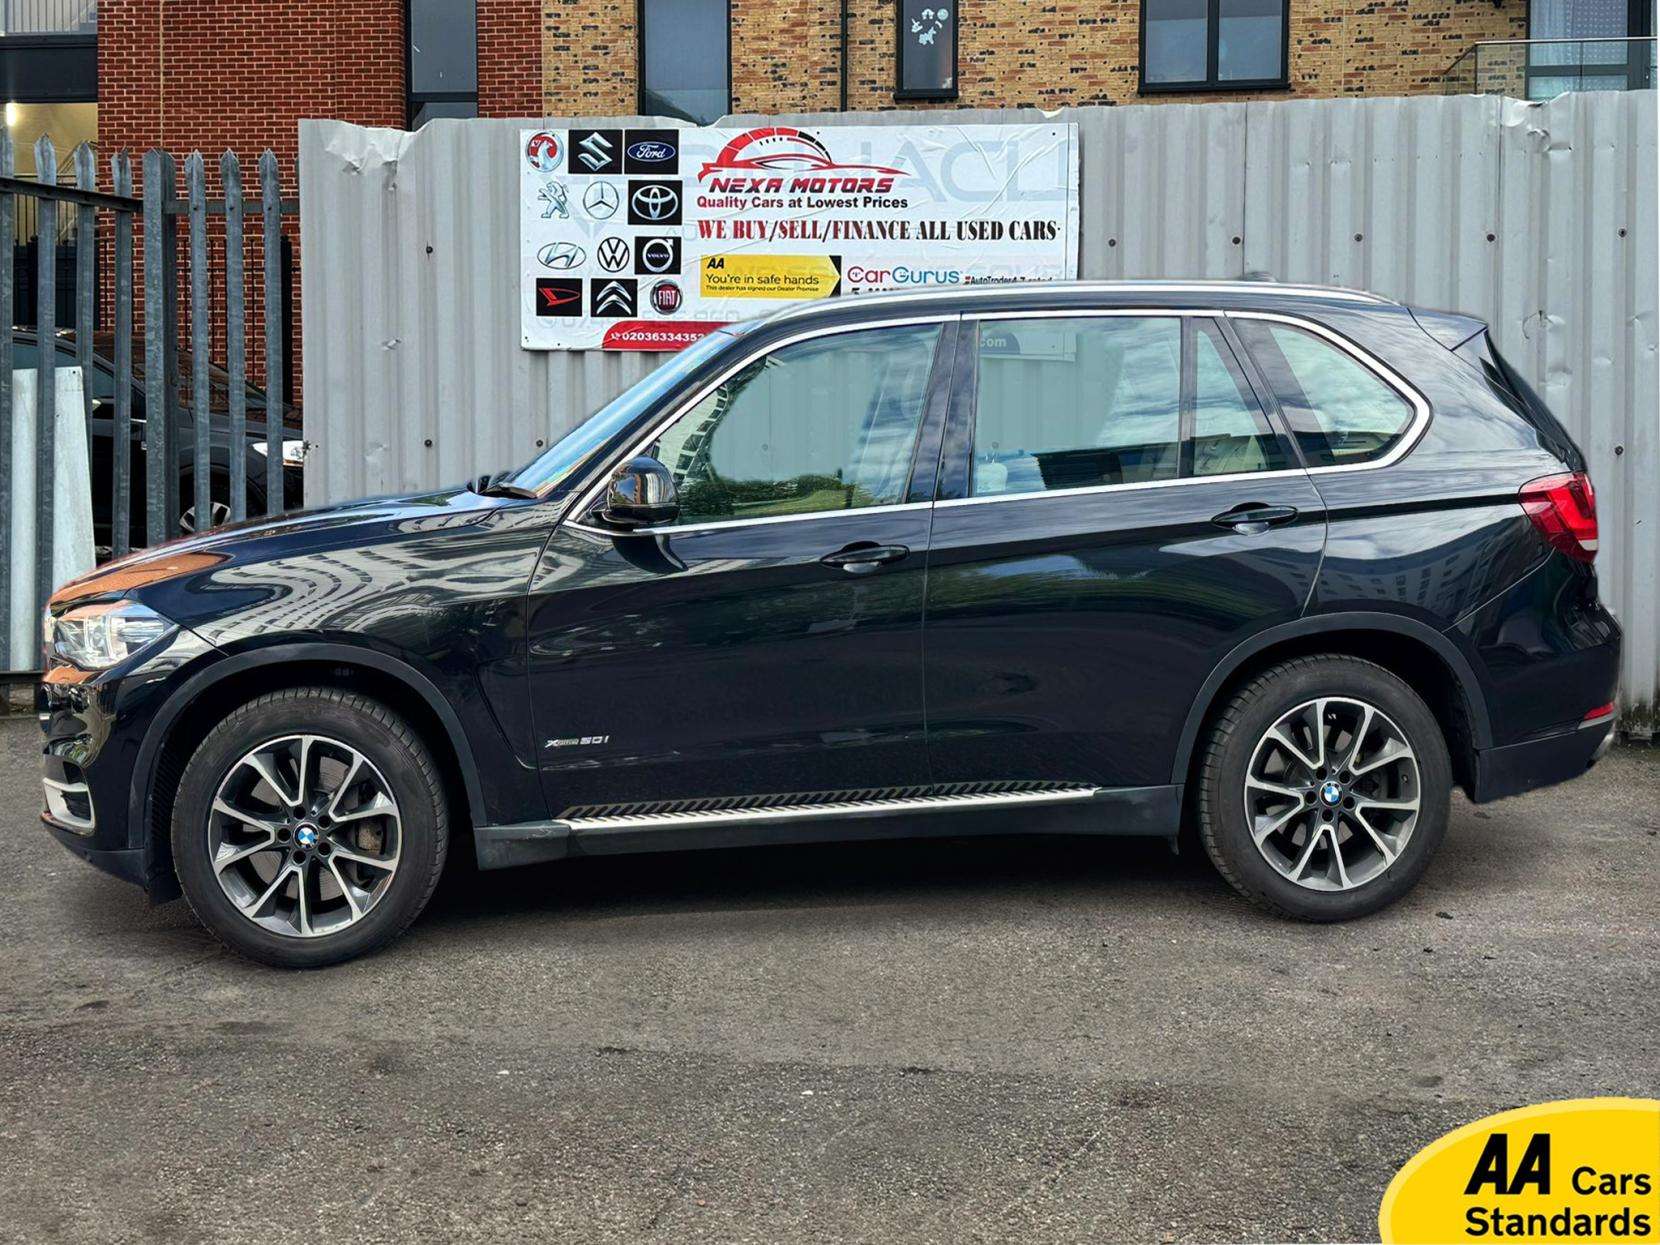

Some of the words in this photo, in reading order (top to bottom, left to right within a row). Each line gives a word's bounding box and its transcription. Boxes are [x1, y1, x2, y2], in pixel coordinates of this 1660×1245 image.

[636, 145, 666, 159] Ford
[709, 178, 783, 194] NEXA
[789, 178, 895, 194] MOTORS
[697, 196, 748, 210] Quality
[752, 196, 784, 209] Cars
[788, 197, 803, 208] at
[807, 197, 859, 209] Lowest
[863, 197, 908, 208] Prices
[697, 220, 727, 240] WE
[733, 219, 911, 243] BUY/SELL/FINANCE
[917, 220, 951, 241] ALL
[956, 220, 1004, 241] USED
[1008, 220, 1057, 241] CARS
[707, 258, 725, 269] AA
[706, 274, 740, 284] You're
[744, 275, 754, 284] in
[757, 274, 781, 285] safe
[784, 275, 819, 285] hands
[847, 266, 960, 284] CarGurus
[658, 290, 677, 306] FIAT
